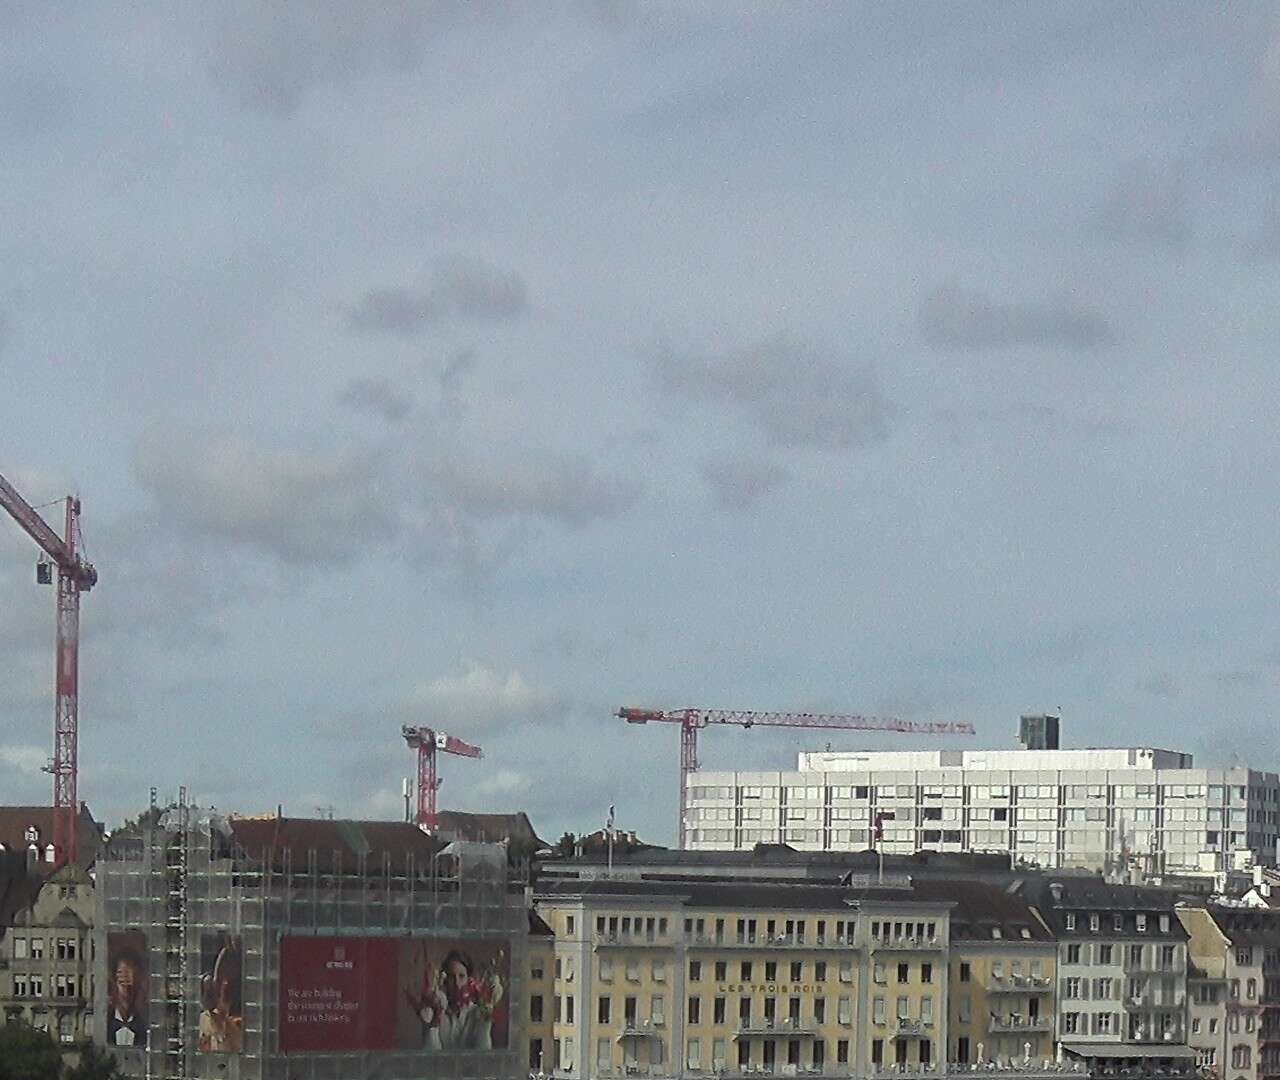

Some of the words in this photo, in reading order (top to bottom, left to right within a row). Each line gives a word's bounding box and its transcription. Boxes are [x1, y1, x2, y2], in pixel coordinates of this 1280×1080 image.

[719, 984, 745, 993] LES
[750, 984, 788, 993] TROIS
[794, 984, 823, 993] ROIS
